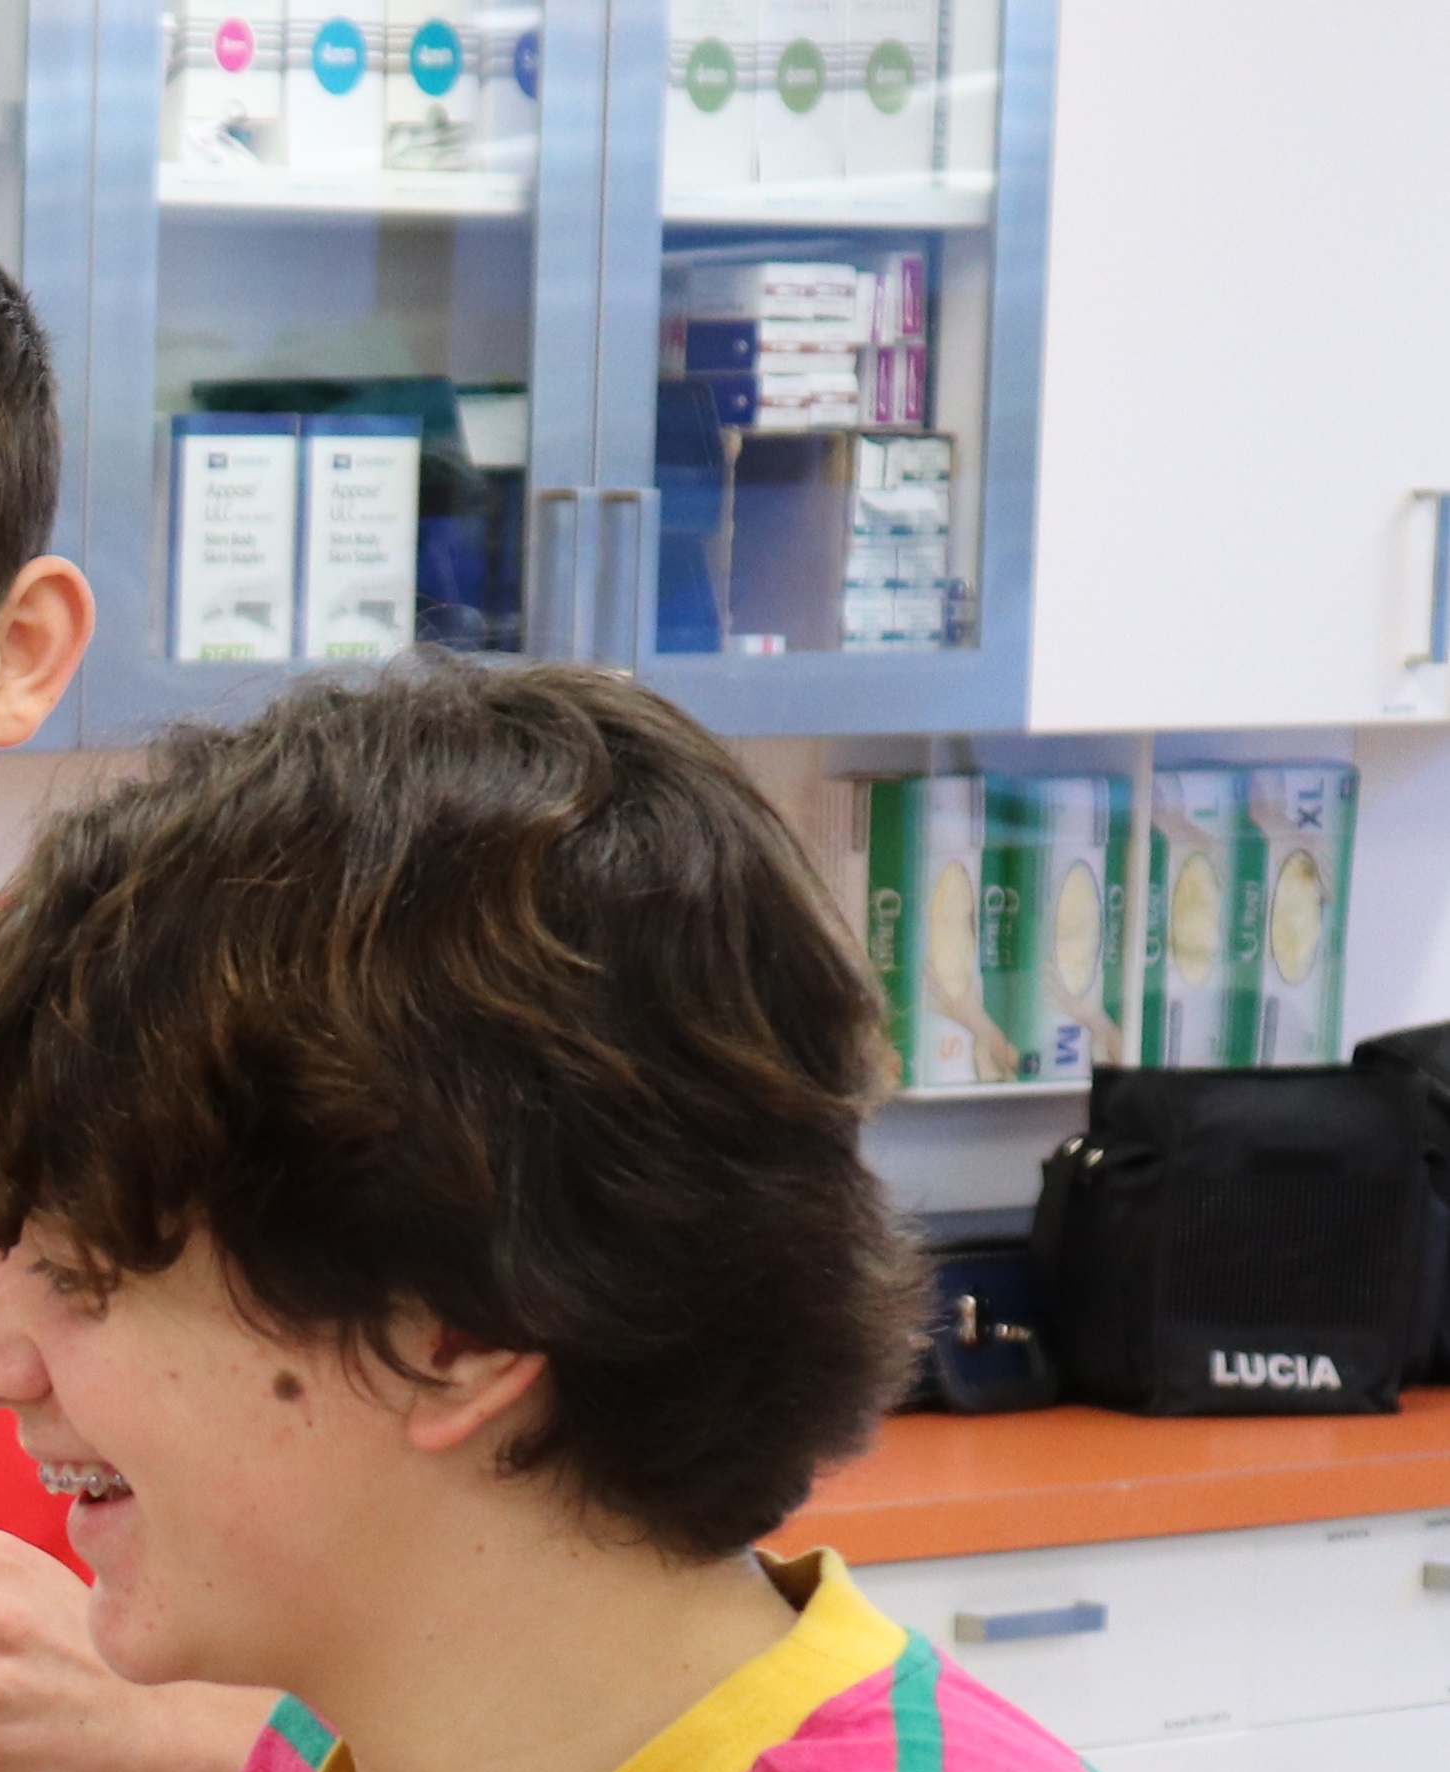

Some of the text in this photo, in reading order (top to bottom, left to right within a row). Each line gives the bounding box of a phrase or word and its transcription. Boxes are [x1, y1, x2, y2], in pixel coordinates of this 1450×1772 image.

[1297, 777, 1324, 829] XL
[939, 1035, 964, 1060] S
[1055, 1025, 1082, 1066] M
[1211, 1350, 1342, 1390] LUCIA
